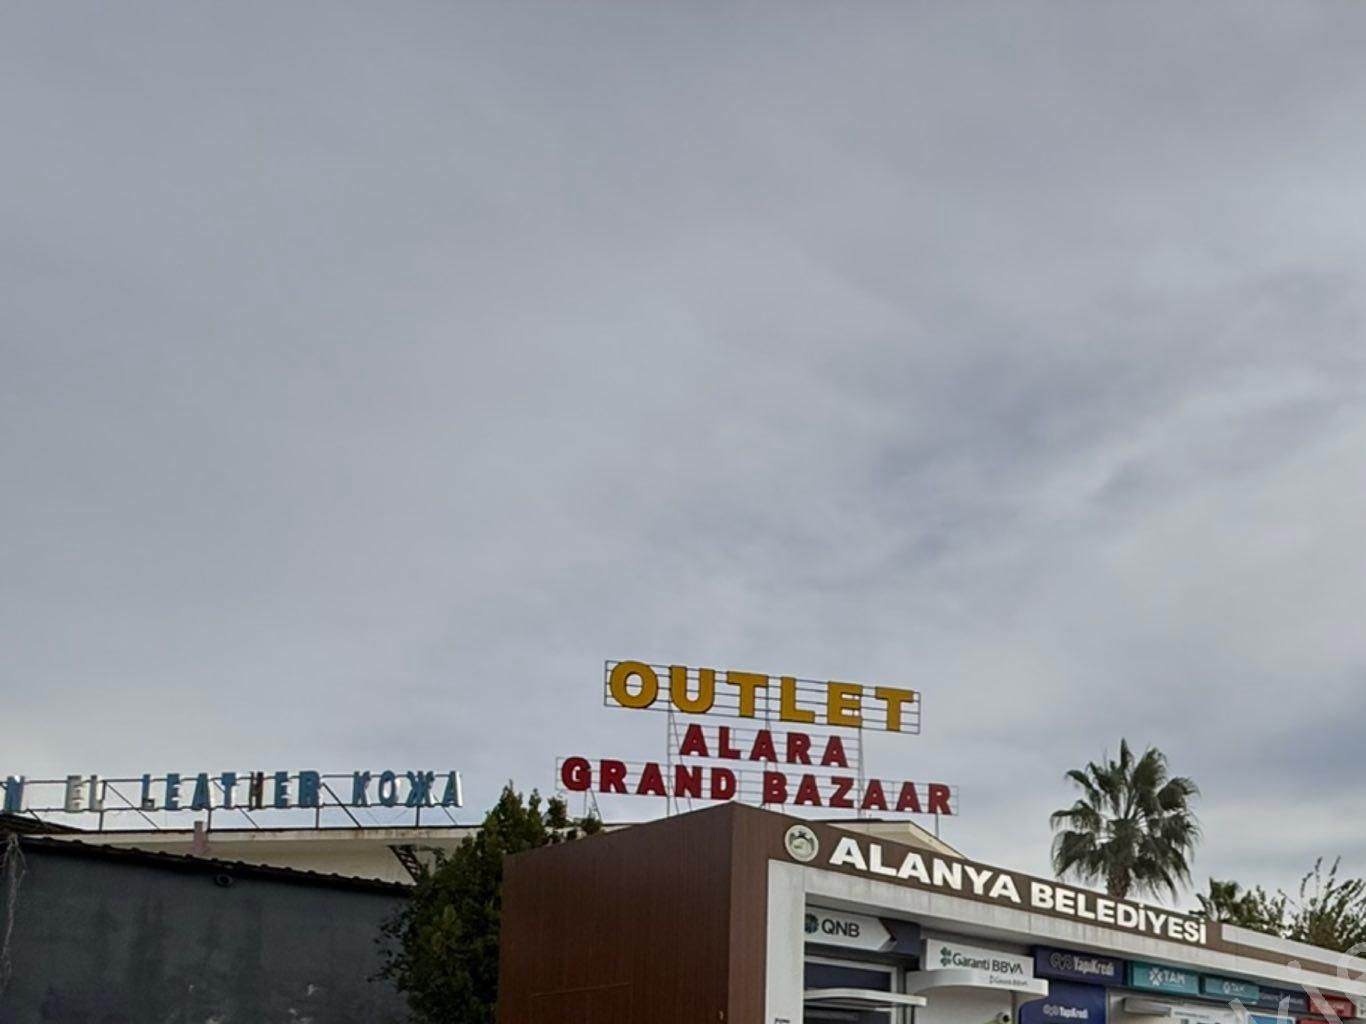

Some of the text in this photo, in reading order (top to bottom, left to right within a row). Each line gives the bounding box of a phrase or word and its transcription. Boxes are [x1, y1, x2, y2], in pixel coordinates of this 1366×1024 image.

[609, 660, 915, 732] OUTLET
[679, 723, 849, 768] ALARA
[140, 770, 322, 812] LEATHER
[561, 757, 952, 815] GRAND BAZAAR
[829, 837, 1206, 945] ALANYA BELEDİYESİ
[821, 918, 860, 938] QNB
[952, 952, 1024, 975] Garanti BBVA
[1162, 970, 1186, 986] TAM
